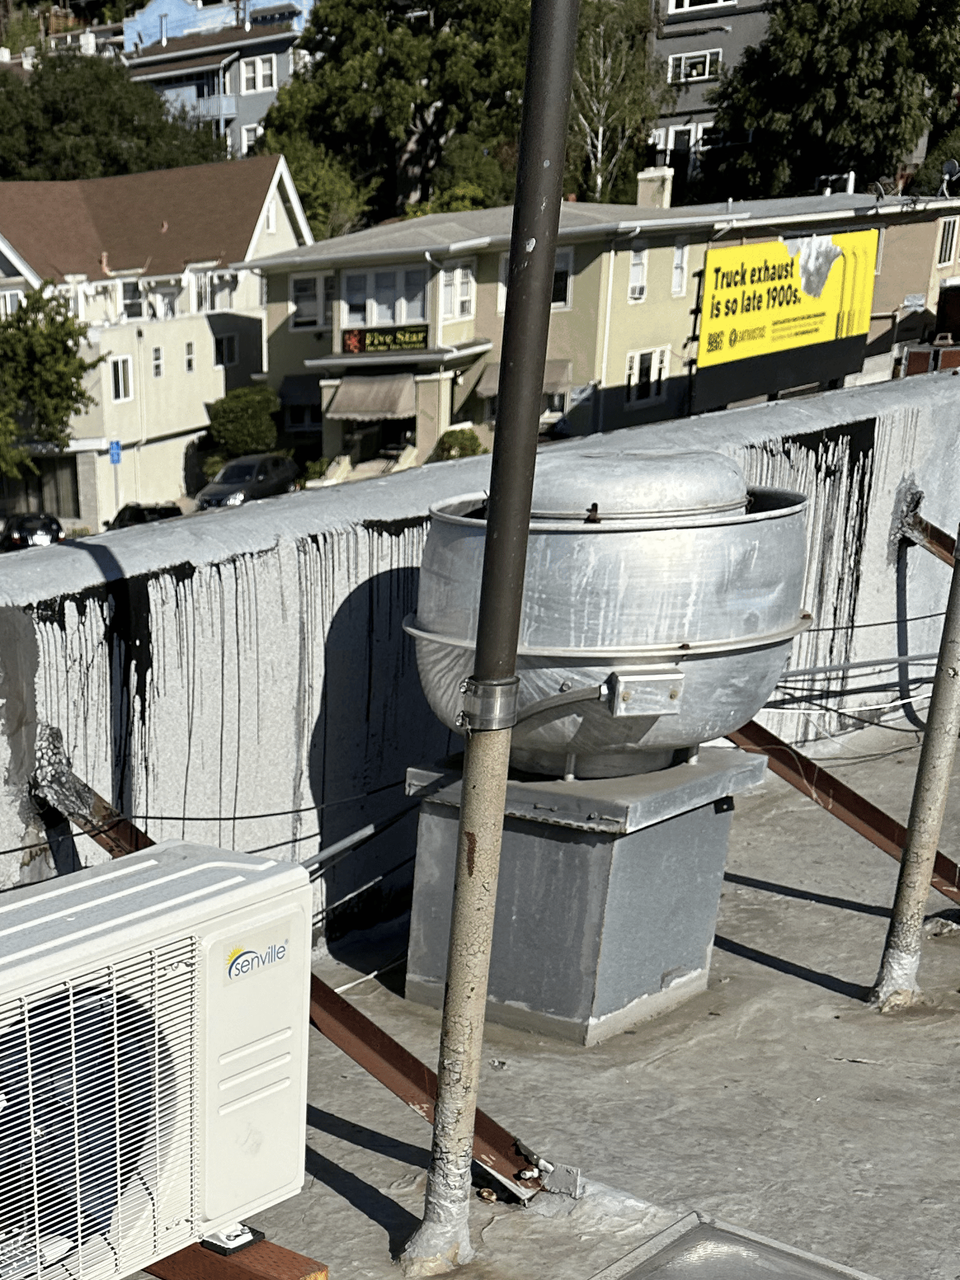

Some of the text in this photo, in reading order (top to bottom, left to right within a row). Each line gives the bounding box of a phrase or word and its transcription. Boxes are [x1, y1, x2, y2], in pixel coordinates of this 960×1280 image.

[714, 257, 794, 290] Truck exhaust
[709, 294, 721, 319] is
[724, 296, 738, 316] so
[740, 290, 763, 314] late
